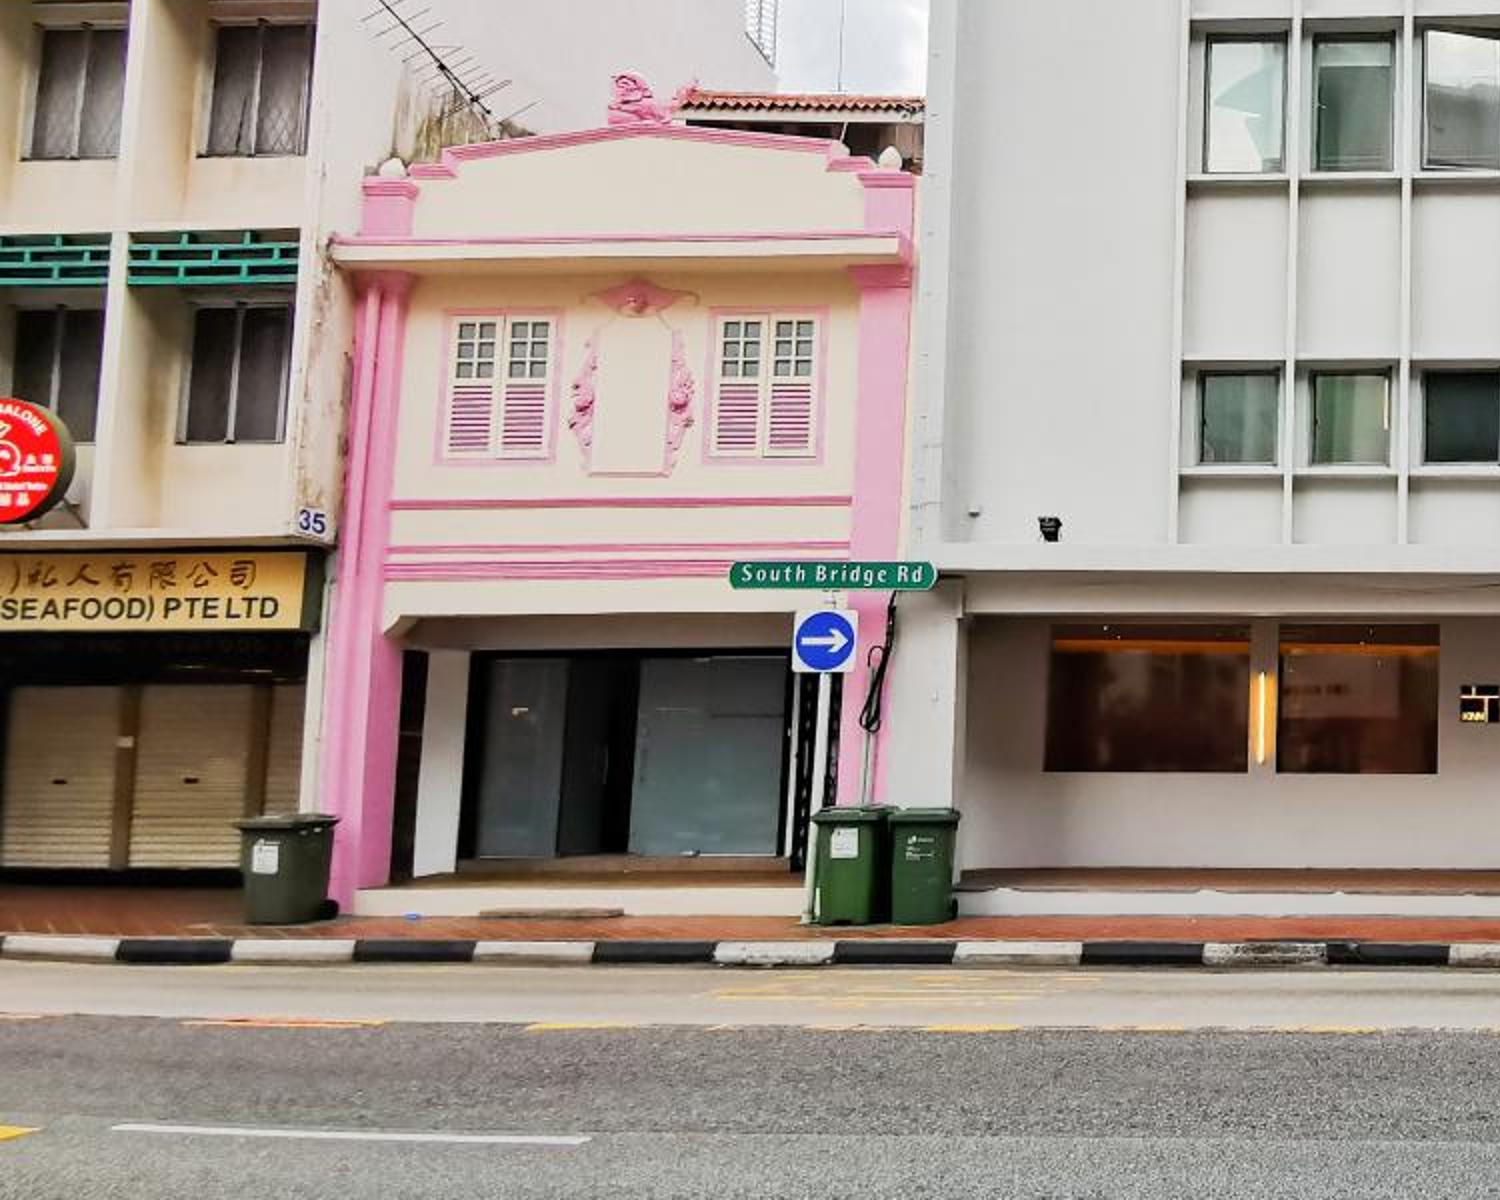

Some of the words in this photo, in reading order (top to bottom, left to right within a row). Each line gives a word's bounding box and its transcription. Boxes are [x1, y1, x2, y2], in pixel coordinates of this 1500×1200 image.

[298, 508, 326, 535] 35
[741, 563, 805, 583] South
[815, 564, 887, 587] Bridge
[897, 563, 923, 583] Rd
[0, 596, 154, 621] SEAFOOD)
[163, 596, 219, 619] PTE
[225, 596, 279, 619] LTD
